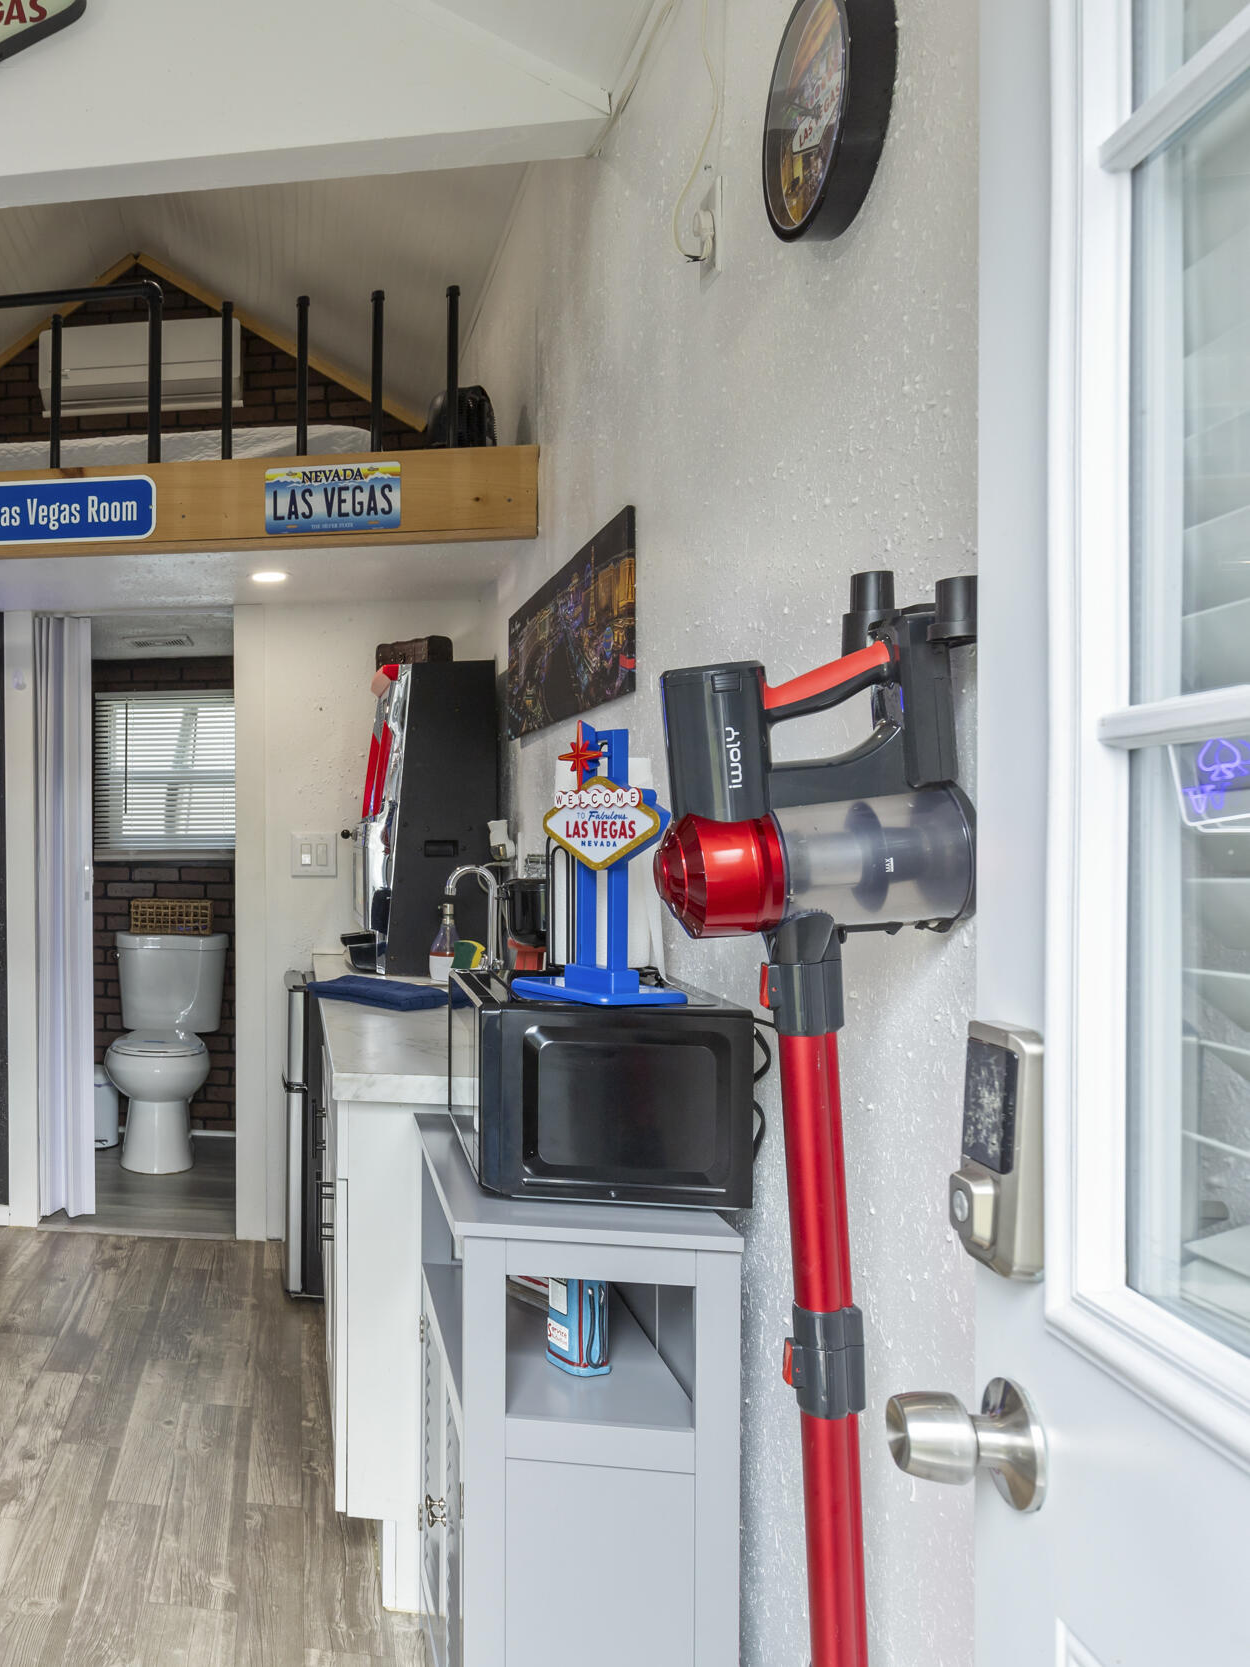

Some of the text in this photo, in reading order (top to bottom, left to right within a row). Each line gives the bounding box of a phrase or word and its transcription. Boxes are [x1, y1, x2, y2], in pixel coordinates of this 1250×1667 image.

[301, 467, 364, 484] NEVADA
[273, 484, 393, 521] LAS VEGAS
[26, 498, 81, 531] Vegas
[87, 495, 138, 523] Room
[725, 726, 743, 789] iwoly
[556, 791, 636, 805] WELCOME
[588, 810, 628, 821] Fabulous
[565, 820, 636, 839] LAS VEGAS
